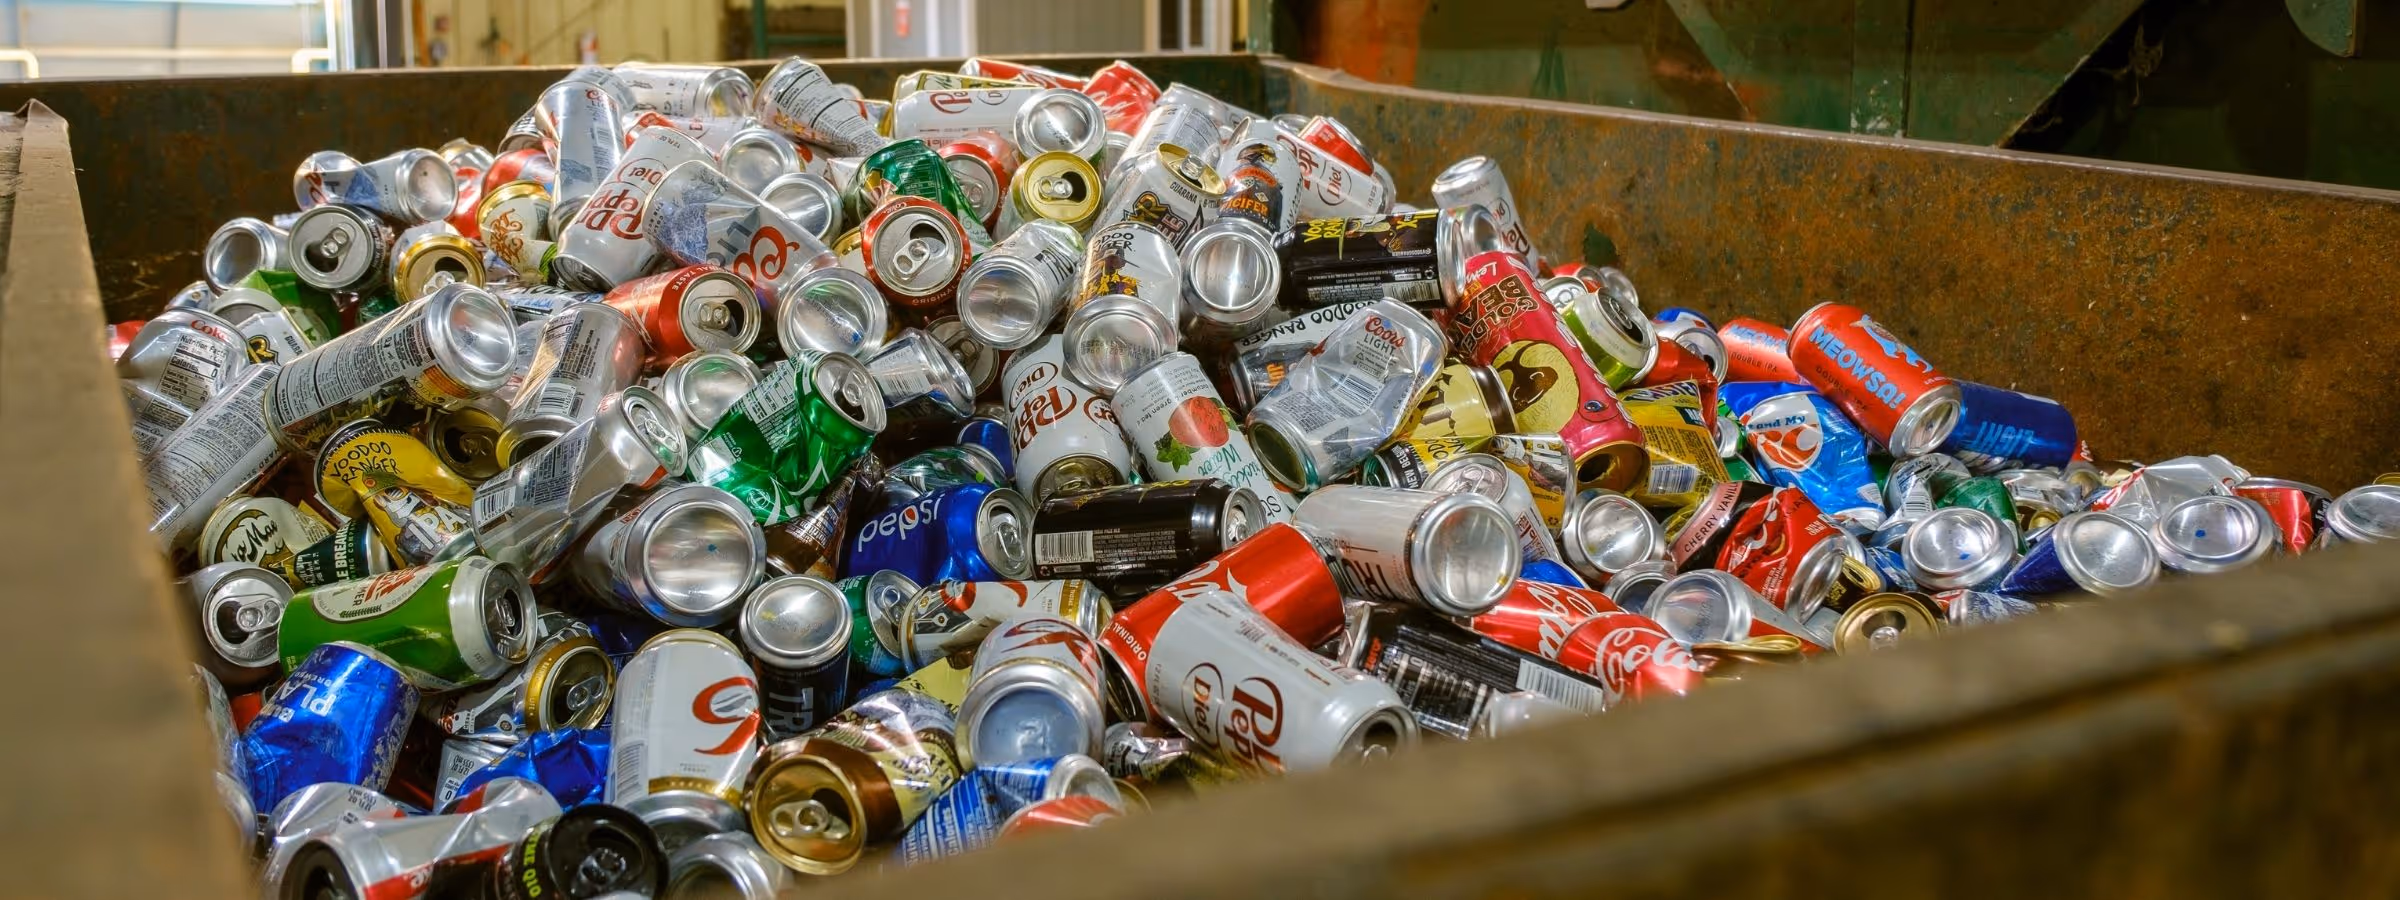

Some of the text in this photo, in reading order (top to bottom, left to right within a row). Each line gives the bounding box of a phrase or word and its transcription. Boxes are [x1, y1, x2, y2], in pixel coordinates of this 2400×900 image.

[628, 164, 664, 186] Diet
[1326, 166, 1343, 200] Diet
[1169, 182, 1198, 205] GUARANA
[1304, 218, 1326, 244] VOO
[1323, 217, 1344, 239] RAN
[671, 267, 700, 292] TASTE
[179, 333, 209, 350] Nutrition
[190, 318, 229, 342] Coke
[1240, 318, 1306, 347] RANGER
[1362, 333, 1397, 356] LIGHT
[1364, 314, 1406, 349] Coors
[169, 355, 199, 374] Calories
[1729, 350, 1780, 375] DOUBLE IPA
[1807, 325, 1908, 411] MEOWSA!
[1814, 364, 1853, 399] DOUBLE
[281, 387, 293, 423] Calories
[1151, 397, 1172, 414] green
[1756, 414, 1807, 431] and My
[329, 439, 393, 479] VOODOO
[339, 456, 405, 488] RANGER
[1196, 443, 1242, 477] Water
[1403, 464, 1419, 489] NEW
[406, 504, 469, 551] IPA
[857, 492, 946, 553] pepsi
[1683, 513, 1719, 553] CHERRY
[1111, 621, 1148, 662] ORIGINAL
[1191, 674, 1213, 736] Diet
[942, 806, 960, 856] Calories
[521, 866, 542, 899] Q10
